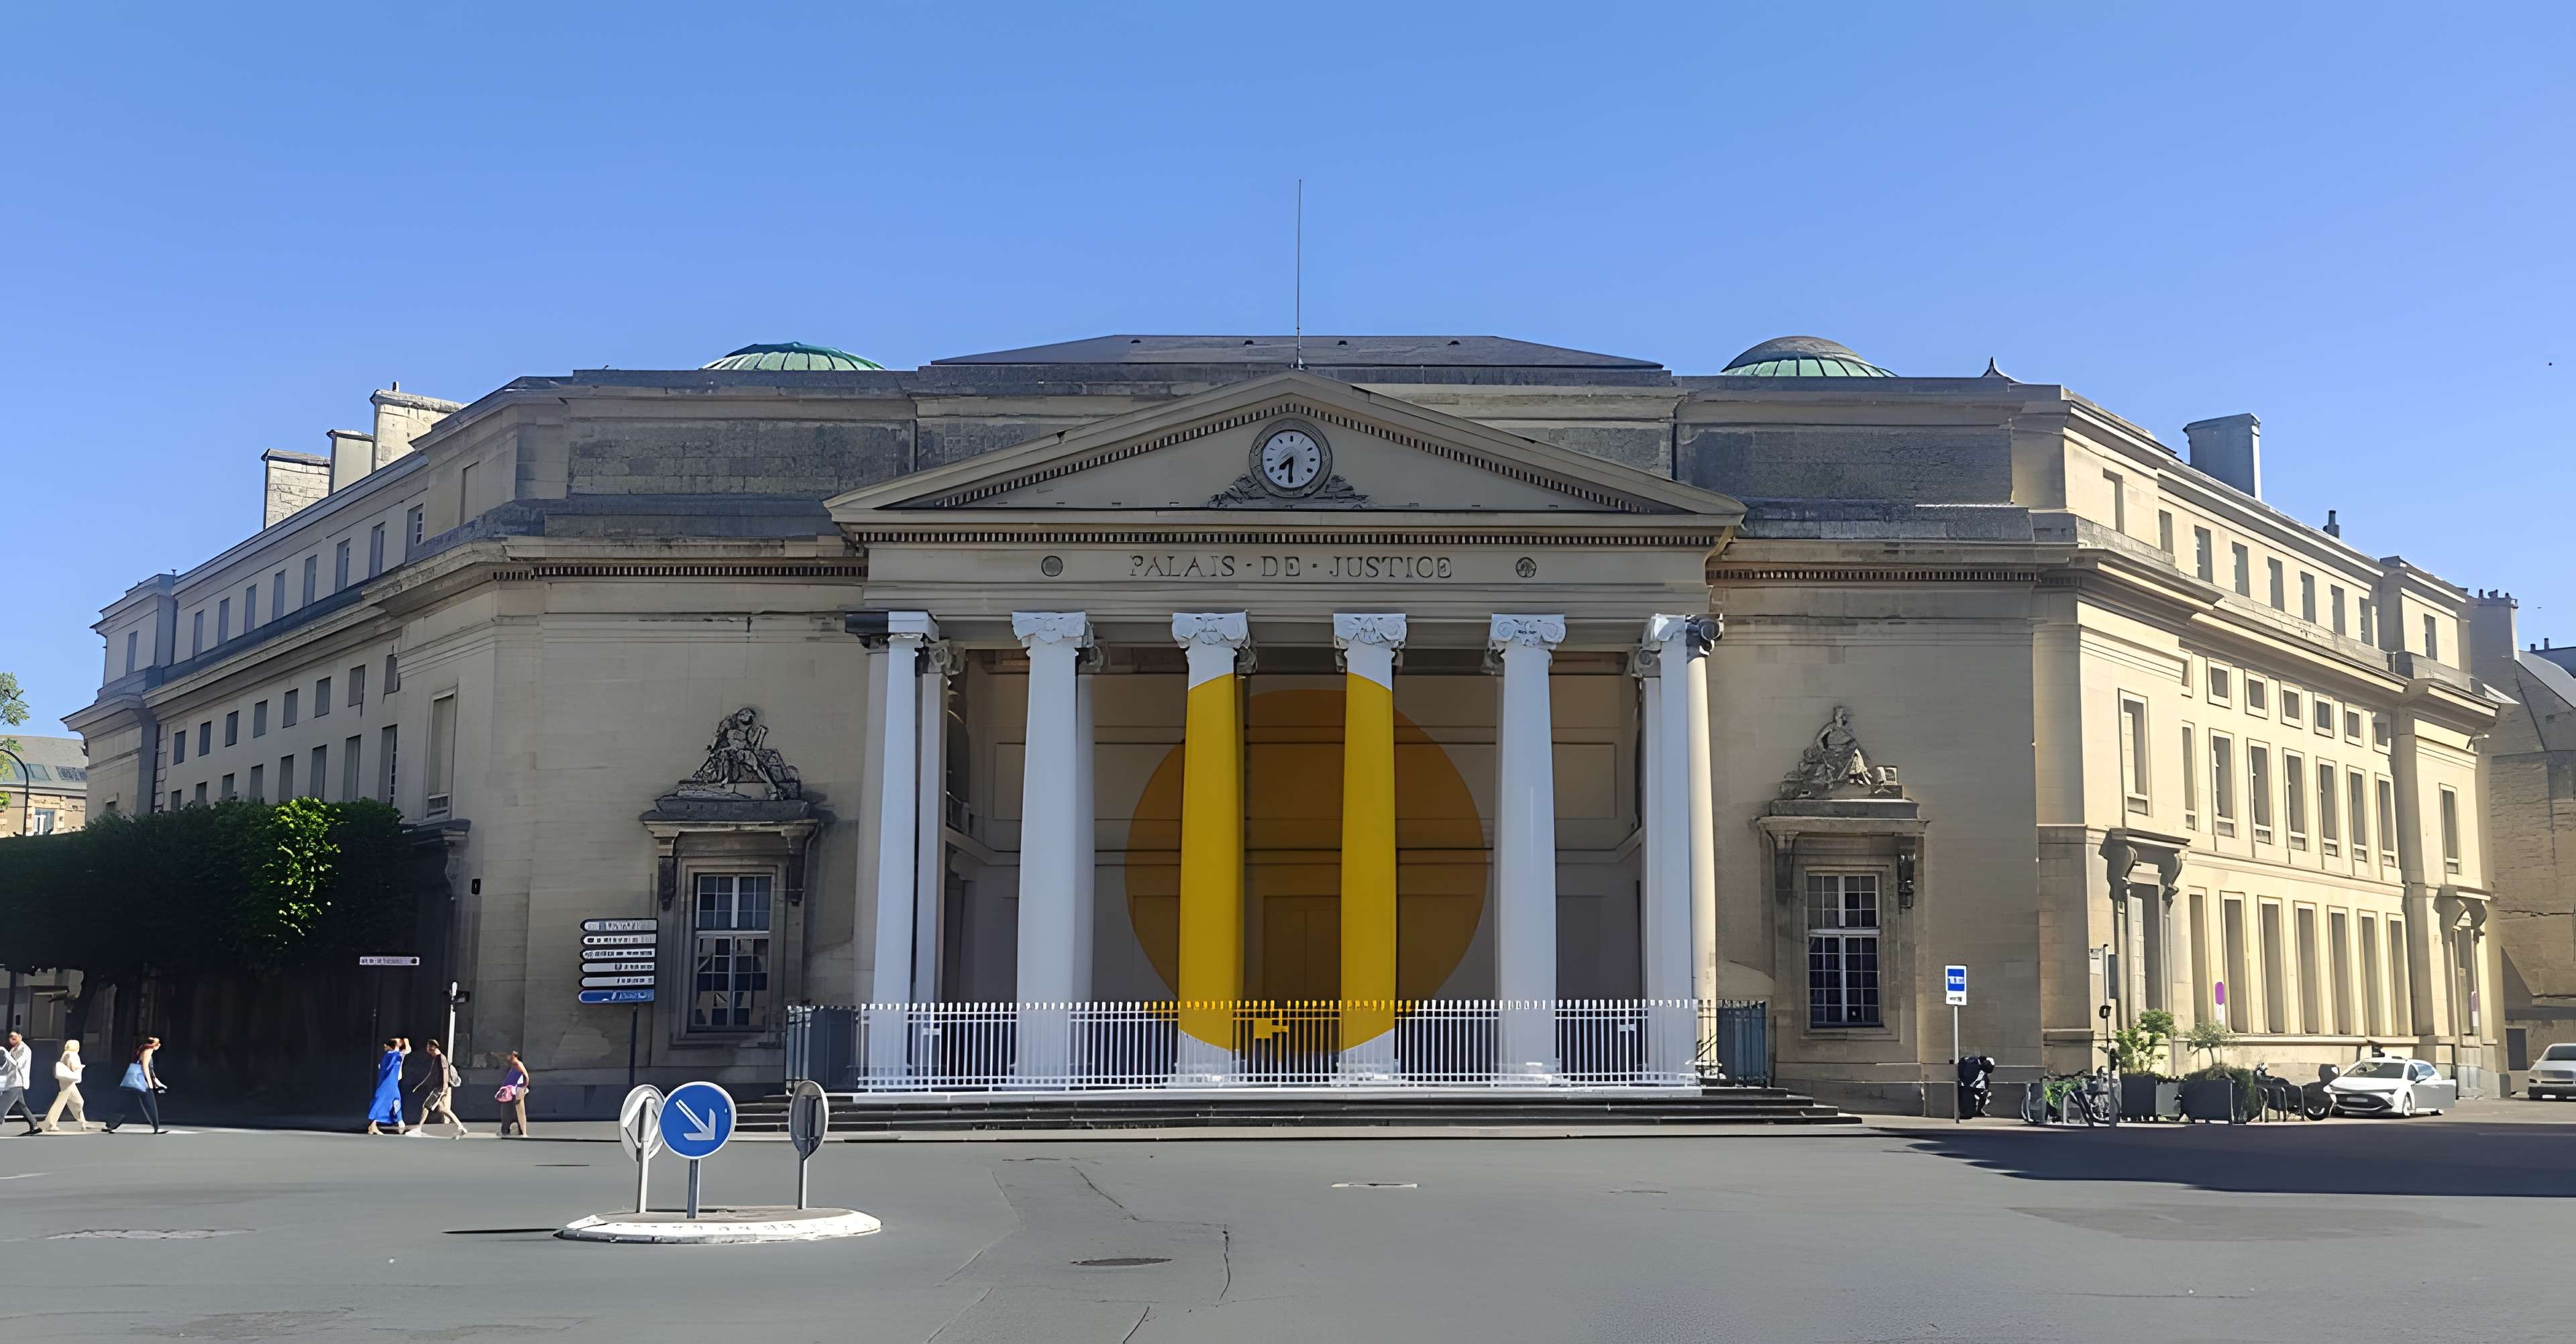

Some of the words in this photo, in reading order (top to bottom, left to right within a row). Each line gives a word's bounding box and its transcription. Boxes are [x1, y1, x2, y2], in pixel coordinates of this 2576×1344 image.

[1130, 555, 1235, 577] PALAIS
[1260, 555, 1301, 577] DE
[1329, 556, 1452, 579] JUSTICE
